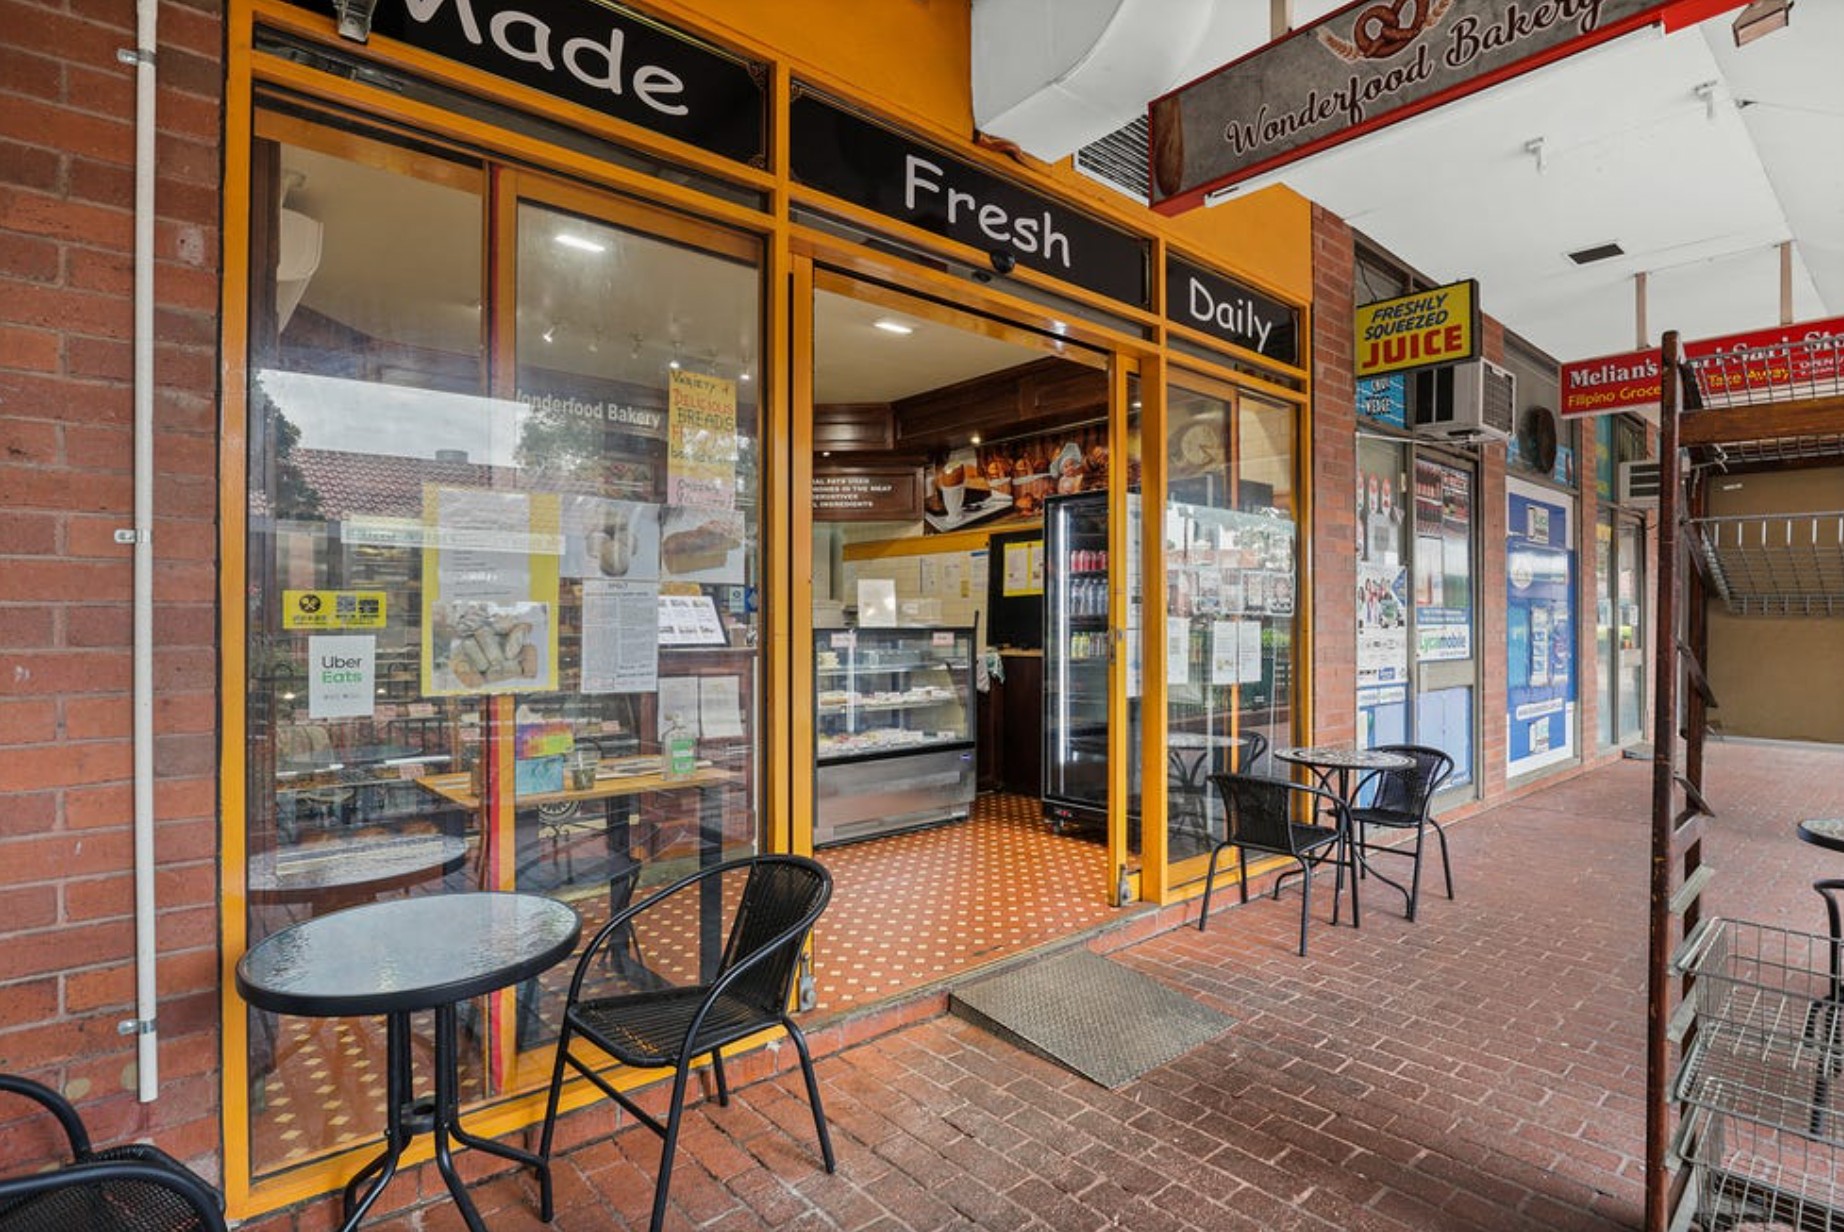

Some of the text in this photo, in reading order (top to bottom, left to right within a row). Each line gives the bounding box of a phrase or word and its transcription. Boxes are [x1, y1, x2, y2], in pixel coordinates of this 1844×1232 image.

[1225, 0, 1602, 156] Wonderfood Bakery
[903, 153, 1071, 268] Fresh
[1190, 276, 1272, 352] Daily
[1372, 292, 1448, 322] FRESHLY
[1364, 310, 1448, 341] SQUEEZED
[1361, 323, 1463, 369] JUICE
[1568, 358, 1659, 389] Melian's
[607, 402, 661, 428] Bakery
[1567, 391, 1616, 408] Filipino
[321, 655, 363, 669] Uber
[321, 670, 363, 684] Eats
